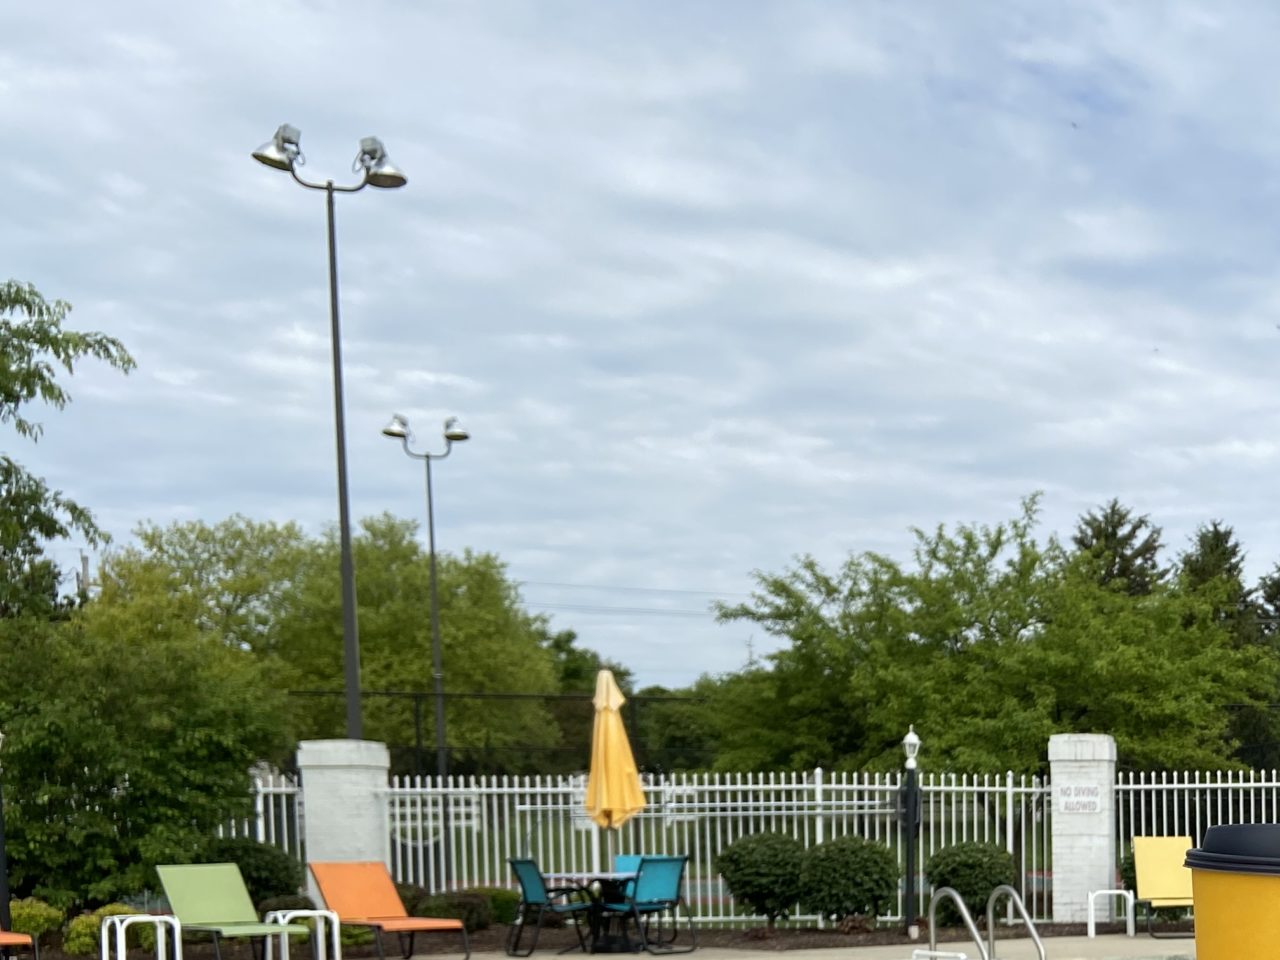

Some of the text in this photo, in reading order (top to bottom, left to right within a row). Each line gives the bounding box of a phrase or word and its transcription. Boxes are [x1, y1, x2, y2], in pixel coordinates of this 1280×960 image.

[1060, 786, 1099, 797] NO DIVING
[1064, 800, 1098, 811] ALLOWED
